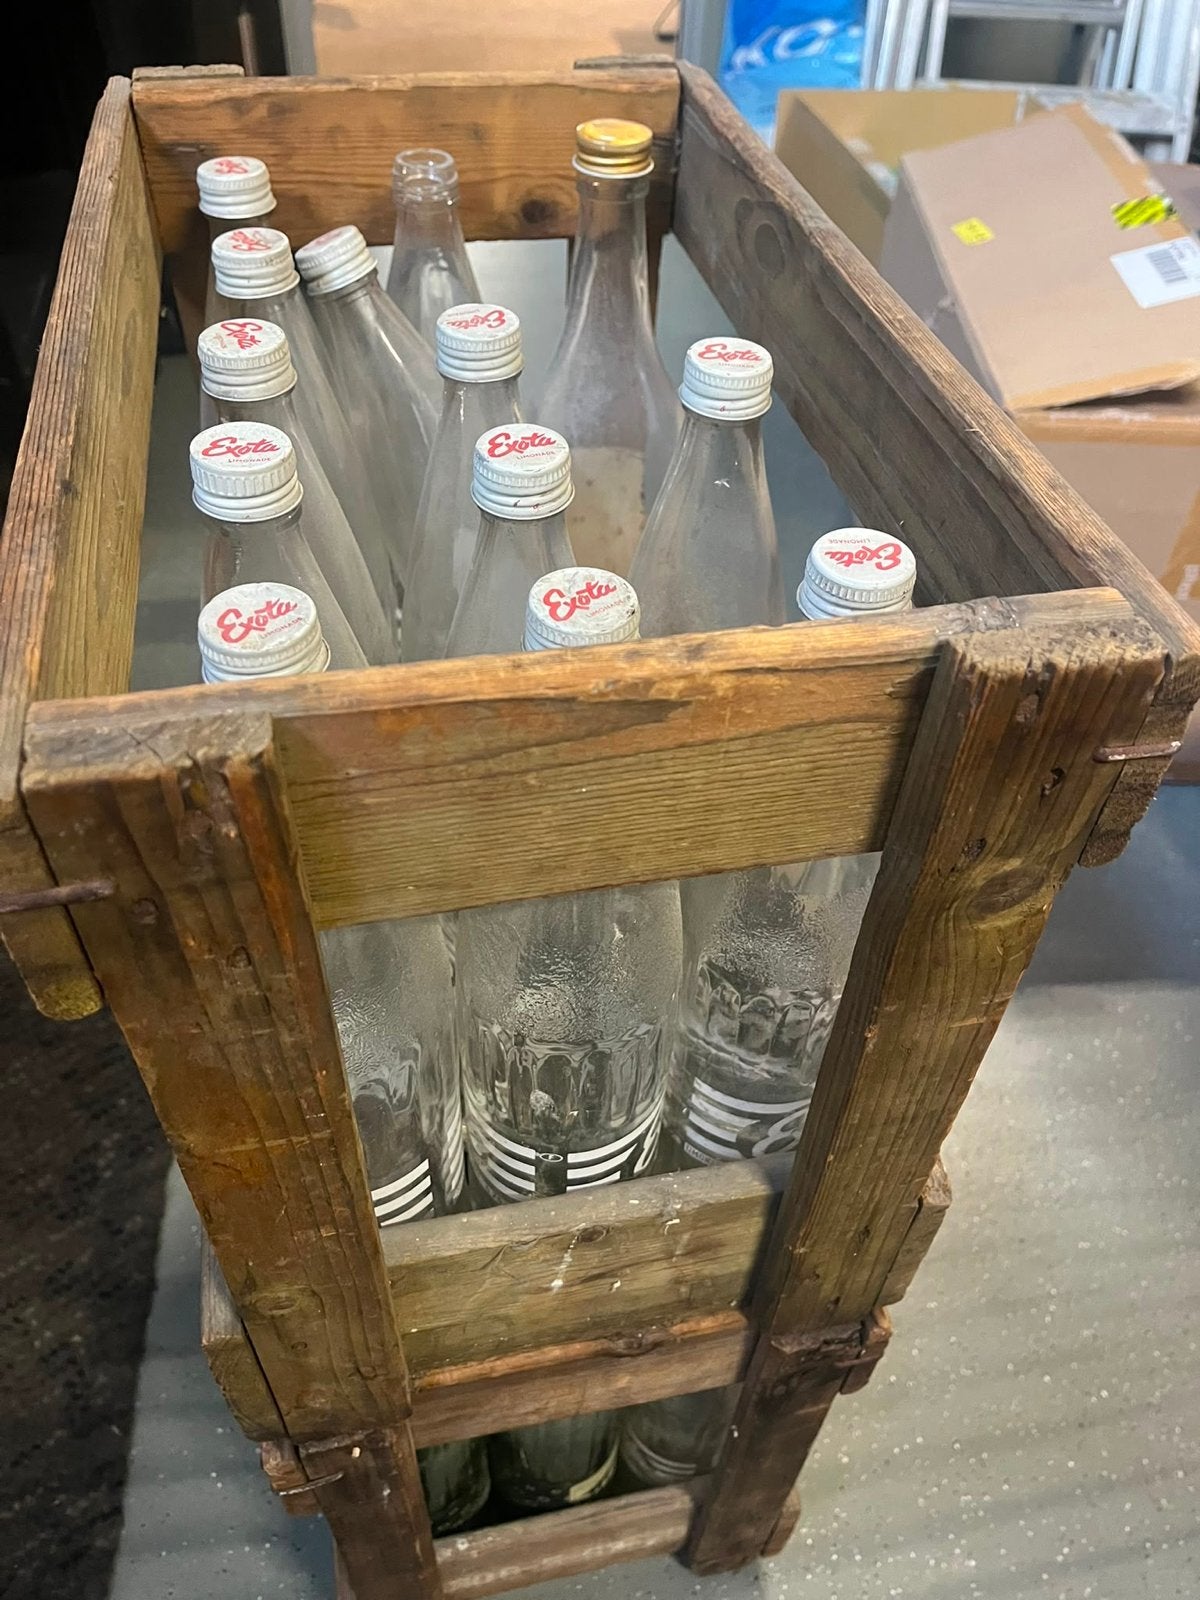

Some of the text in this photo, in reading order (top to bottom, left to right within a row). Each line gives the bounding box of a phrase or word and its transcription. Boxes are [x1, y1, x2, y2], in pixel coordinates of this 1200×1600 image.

[697, 343, 763, 362] Exota
[201, 436, 281, 458] Exota
[486, 431, 557, 459] Exota
[825, 542, 902, 571] Exota
[542, 580, 617, 622] Exota
[216, 598, 298, 644] Exota
